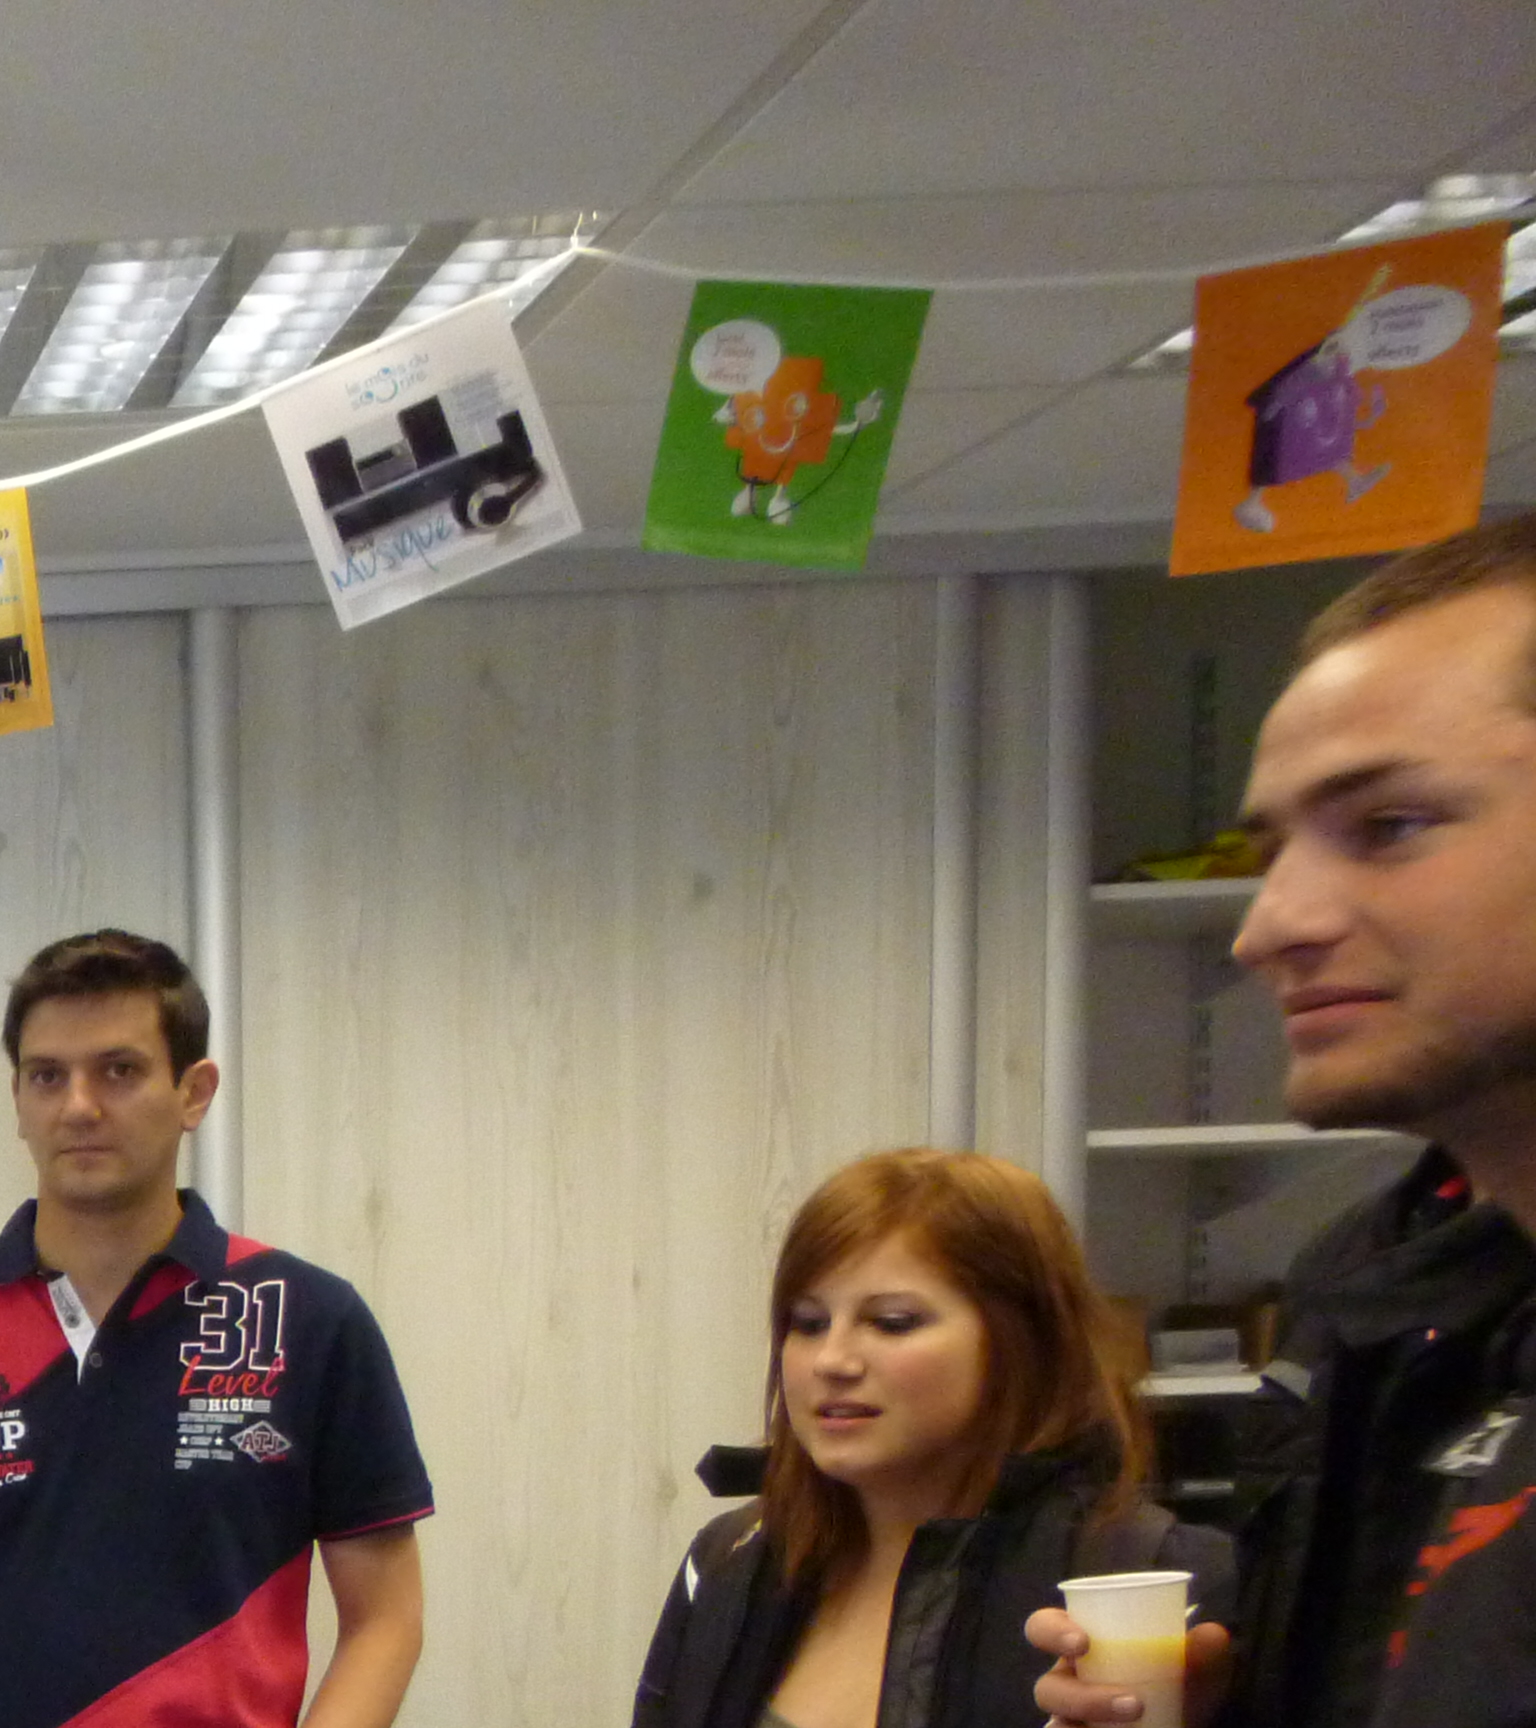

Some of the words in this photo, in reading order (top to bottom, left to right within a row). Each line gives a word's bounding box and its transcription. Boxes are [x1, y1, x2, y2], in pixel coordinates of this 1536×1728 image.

[331, 514, 451, 593] Musique
[179, 1280, 285, 1370] 31
[178, 1355, 286, 1397] Level
[208, 1398, 253, 1412] HIGH
